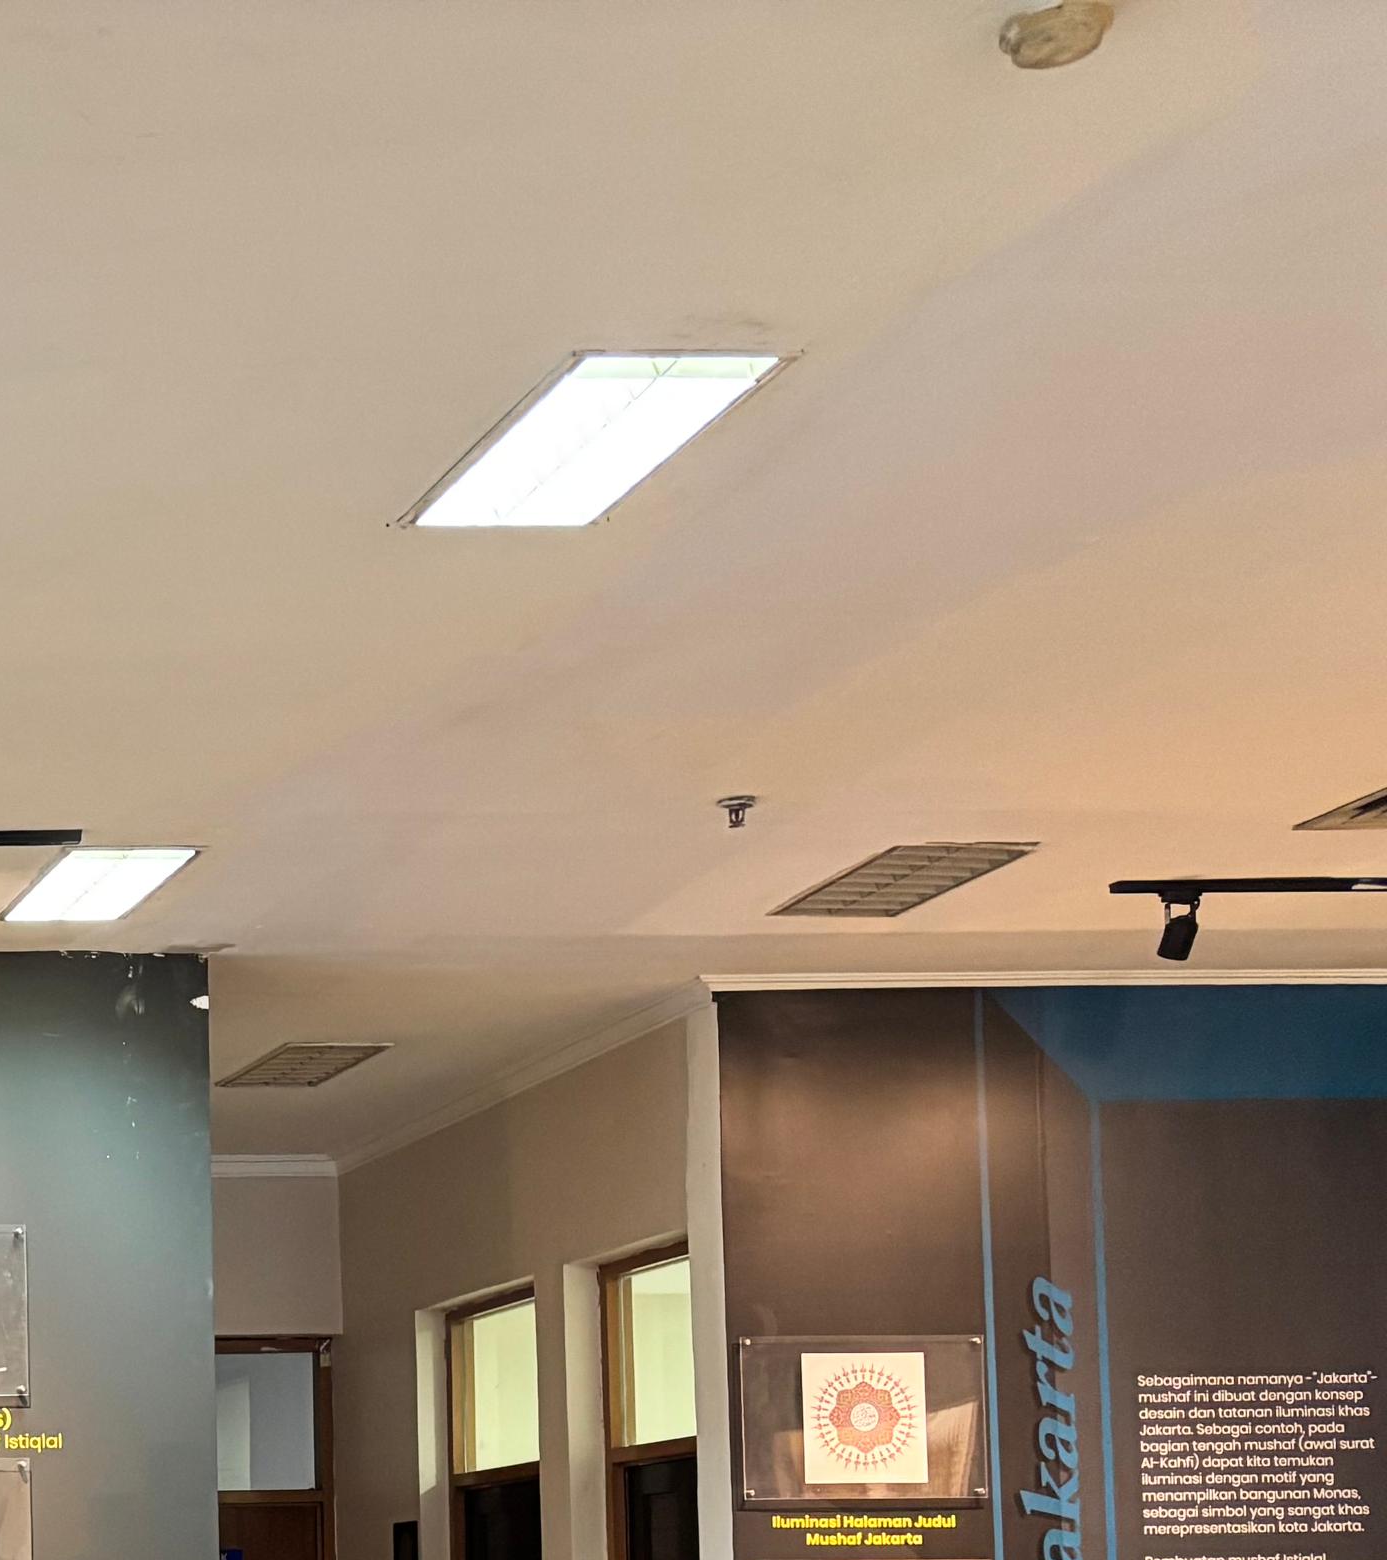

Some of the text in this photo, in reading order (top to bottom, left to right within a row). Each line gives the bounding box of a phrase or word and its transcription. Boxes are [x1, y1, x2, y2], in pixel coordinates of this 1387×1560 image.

[4, 1433, 64, 1454] Istiqlal
[771, 1514, 957, 1529] Iluminasi Halaman Judul
[805, 1532, 923, 1547] Mushaf Jakarta
